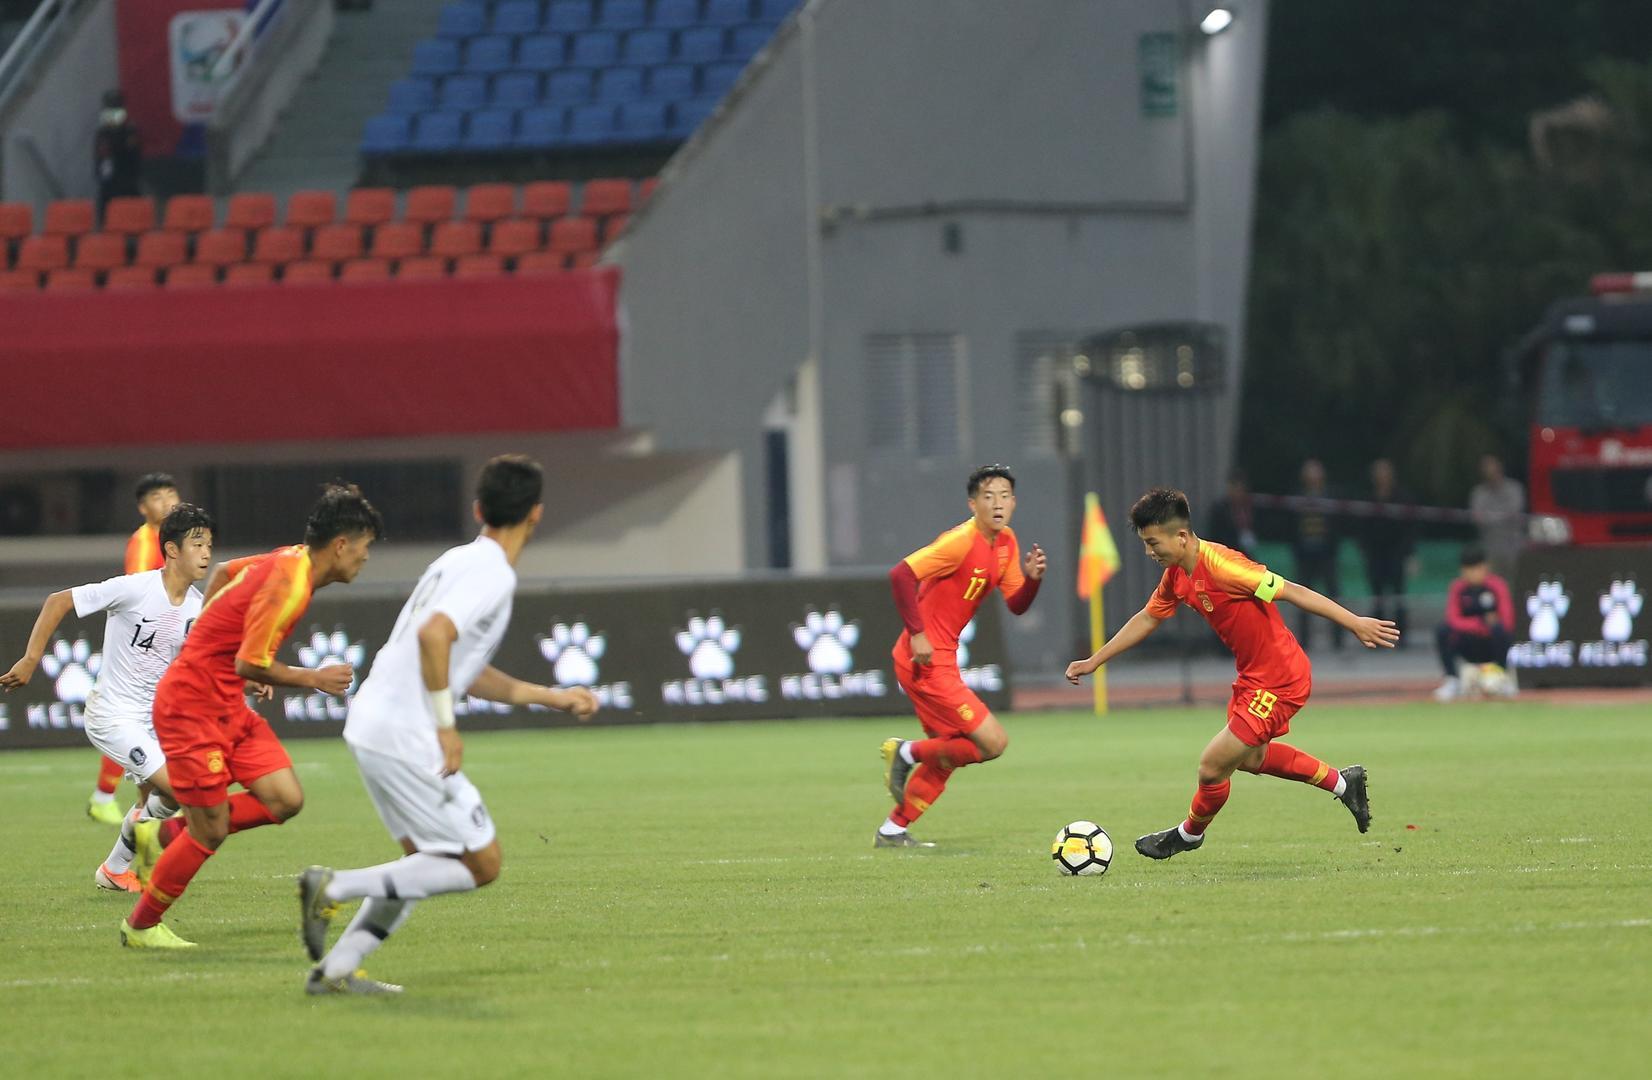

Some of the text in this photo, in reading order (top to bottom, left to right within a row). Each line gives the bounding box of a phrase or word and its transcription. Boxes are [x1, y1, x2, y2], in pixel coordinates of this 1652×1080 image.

[963, 577, 987, 600] 17
[130, 623, 156, 652] 14
[662, 676, 768, 704] KELME
[781, 670, 887, 699] KELME
[1248, 689, 1277, 719] 18
